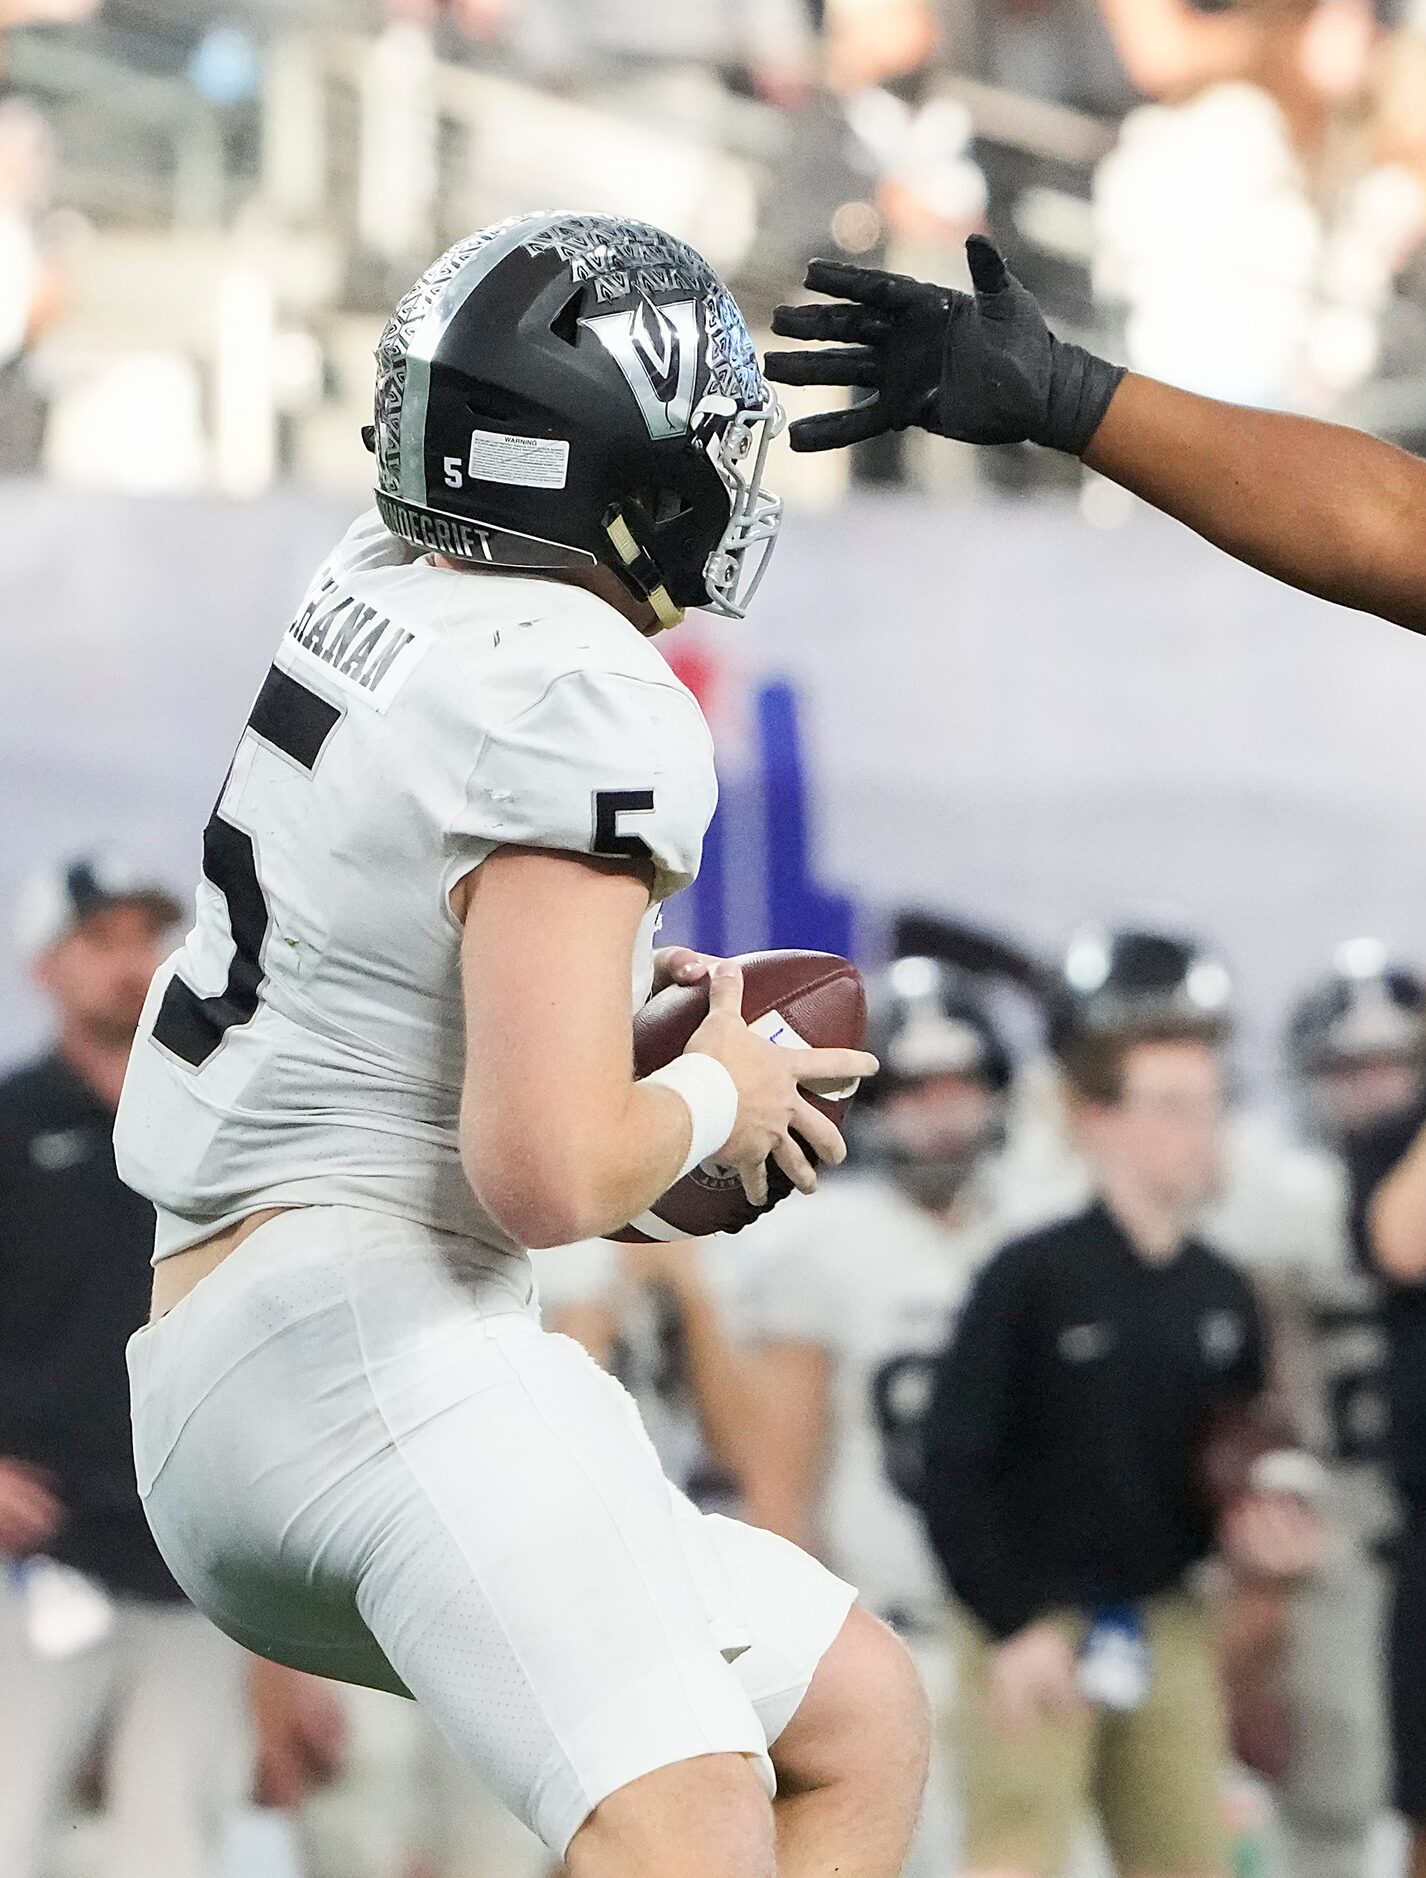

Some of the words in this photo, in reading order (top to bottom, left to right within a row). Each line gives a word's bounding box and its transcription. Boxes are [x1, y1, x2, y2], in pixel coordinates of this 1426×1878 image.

[504, 436, 538, 447] WARNING
[443, 456, 463, 489] 5
[150, 661, 344, 1070] 5
